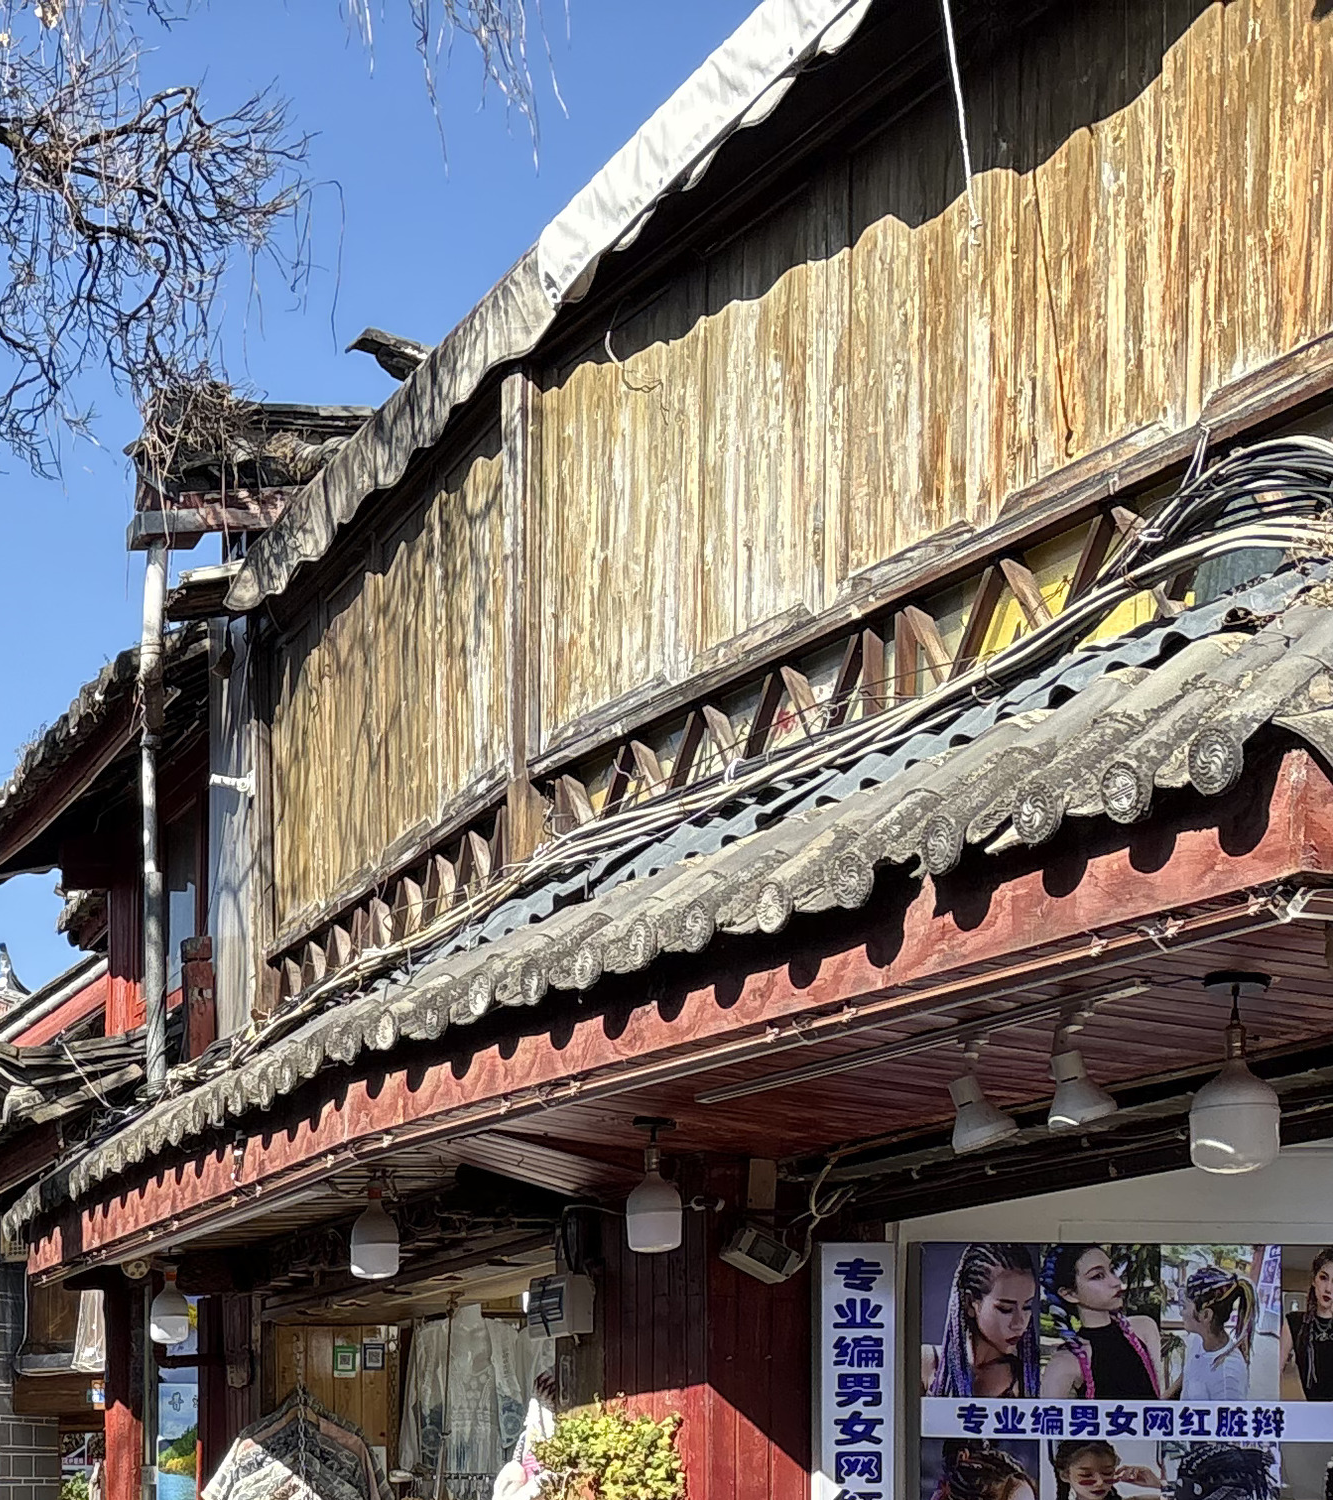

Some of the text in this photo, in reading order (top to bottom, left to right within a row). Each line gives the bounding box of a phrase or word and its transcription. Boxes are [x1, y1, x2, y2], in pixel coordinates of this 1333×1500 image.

[957, 1403, 1285, 1438] 专业编男女网红脏辫
